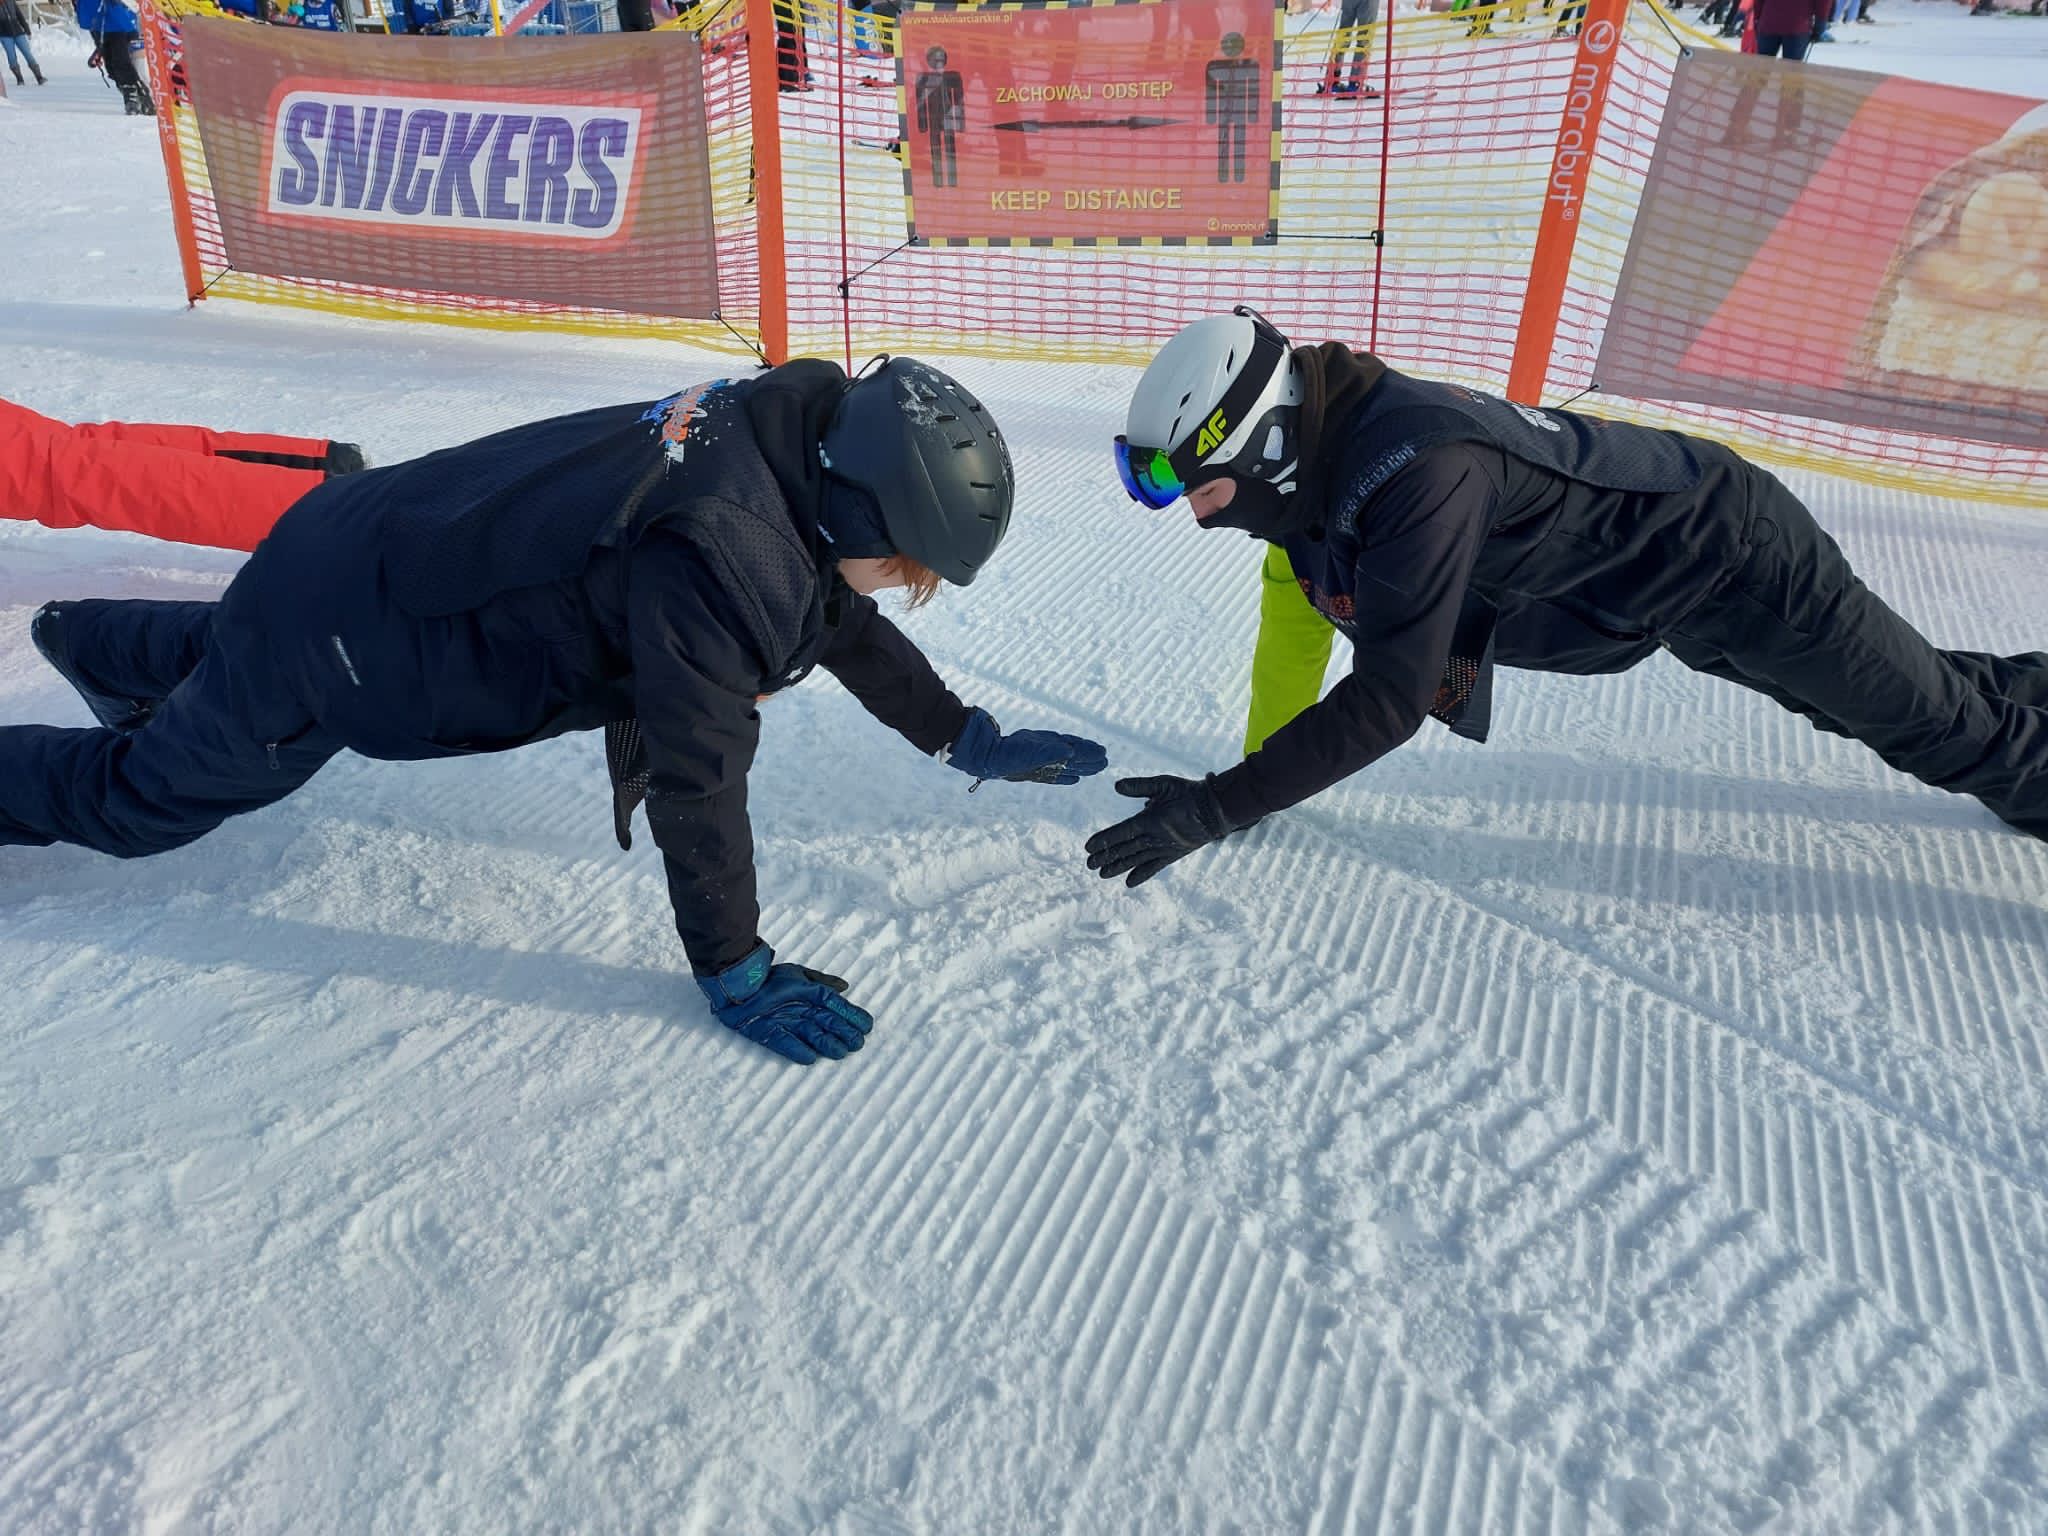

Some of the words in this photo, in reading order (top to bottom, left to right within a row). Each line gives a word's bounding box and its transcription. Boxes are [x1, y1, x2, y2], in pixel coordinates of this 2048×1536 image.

[996, 85, 1093, 103] ZACHOWAJ
[1102, 81, 1173, 101] ODSTĘP
[278, 101, 630, 229] SNICKERS
[991, 190, 1052, 211] KEEP
[1064, 188, 1183, 210] DISTANCE
[1196, 408, 1227, 457] 4F
